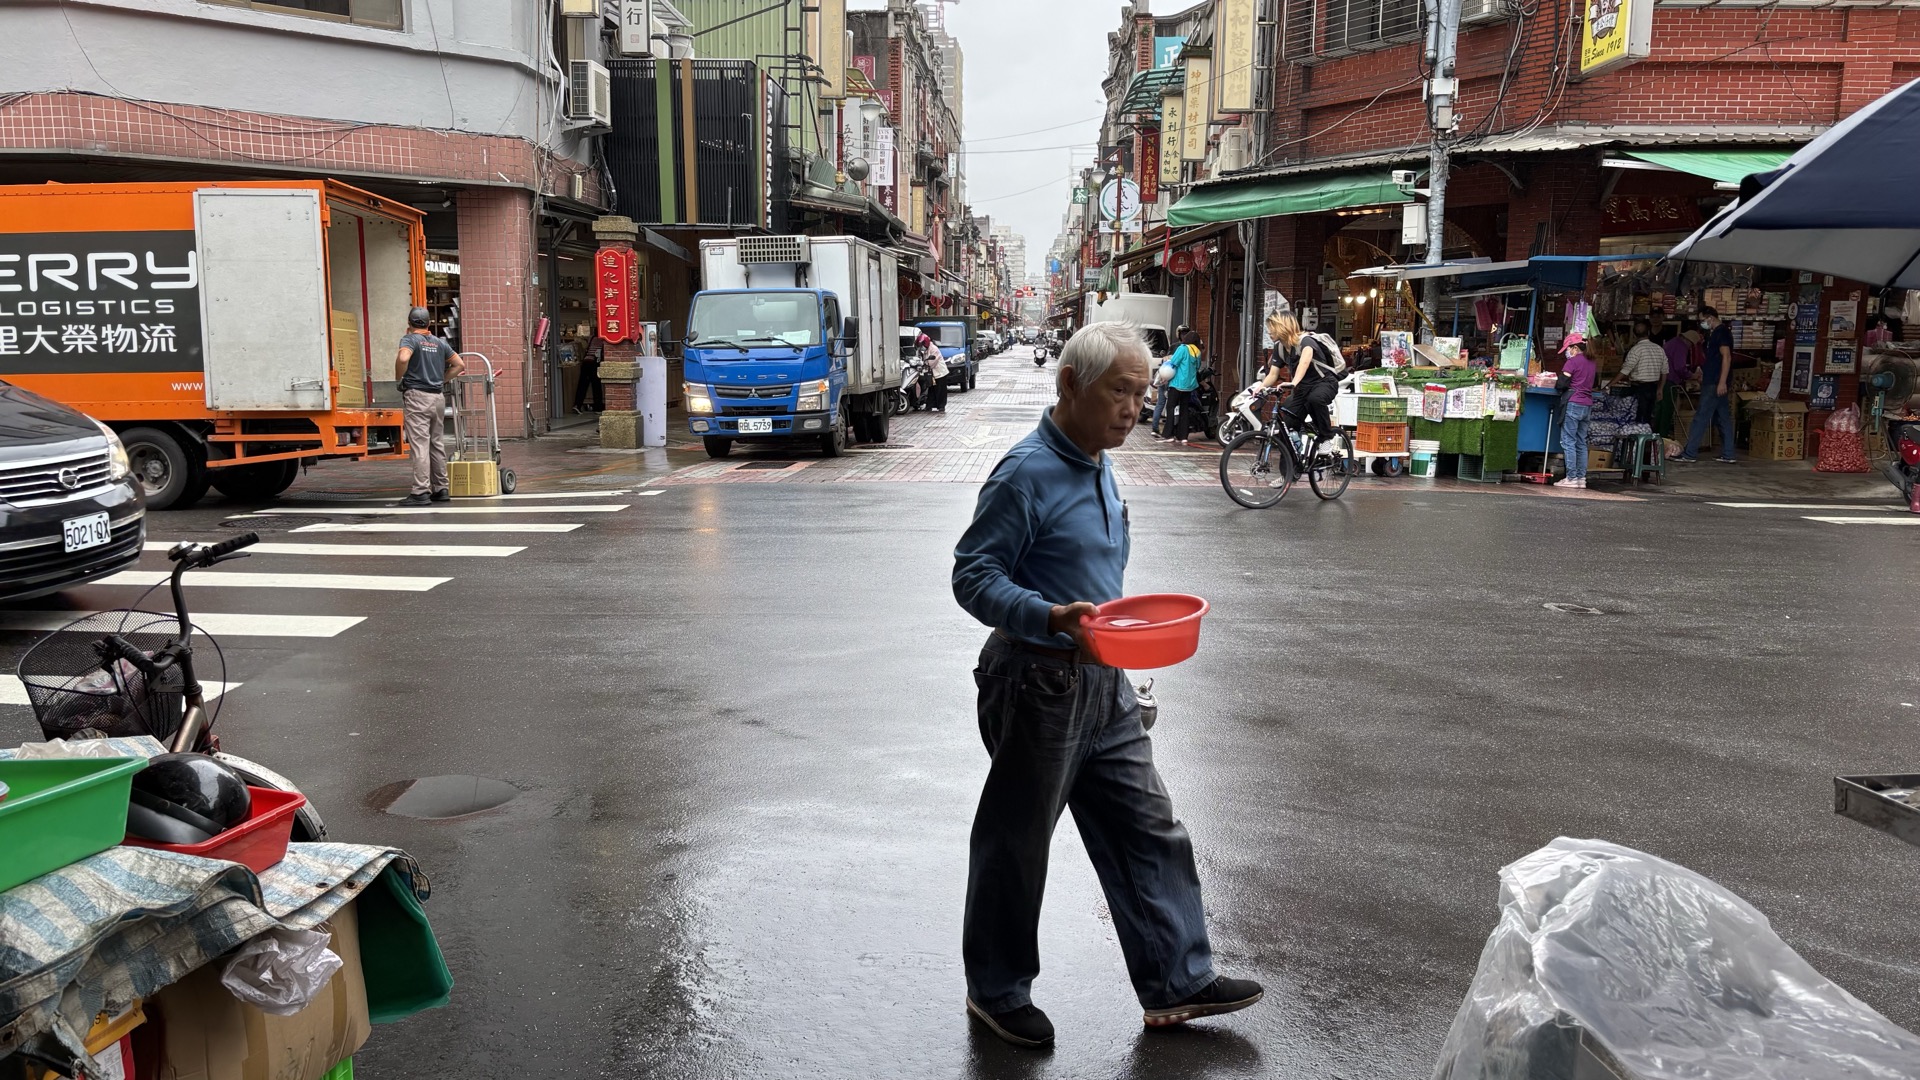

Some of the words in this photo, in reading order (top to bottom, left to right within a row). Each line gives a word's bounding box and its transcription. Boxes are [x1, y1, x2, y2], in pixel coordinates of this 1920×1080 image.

[1591, 48, 1605, 60] Since
[1606, 37, 1622, 53] 1912
[1166, 107, 1178, 147] 永利行
[1074, 189, 1087, 203] 茶
[603, 256, 620, 333] 迪化街商圈
[0, 299, 175, 317] LOGISTICS
[0, 323, 178, 355] 里大榮物流
[739, 422, 772, 431] RBL-5739
[65, 519, 110, 547] 5021-QX
